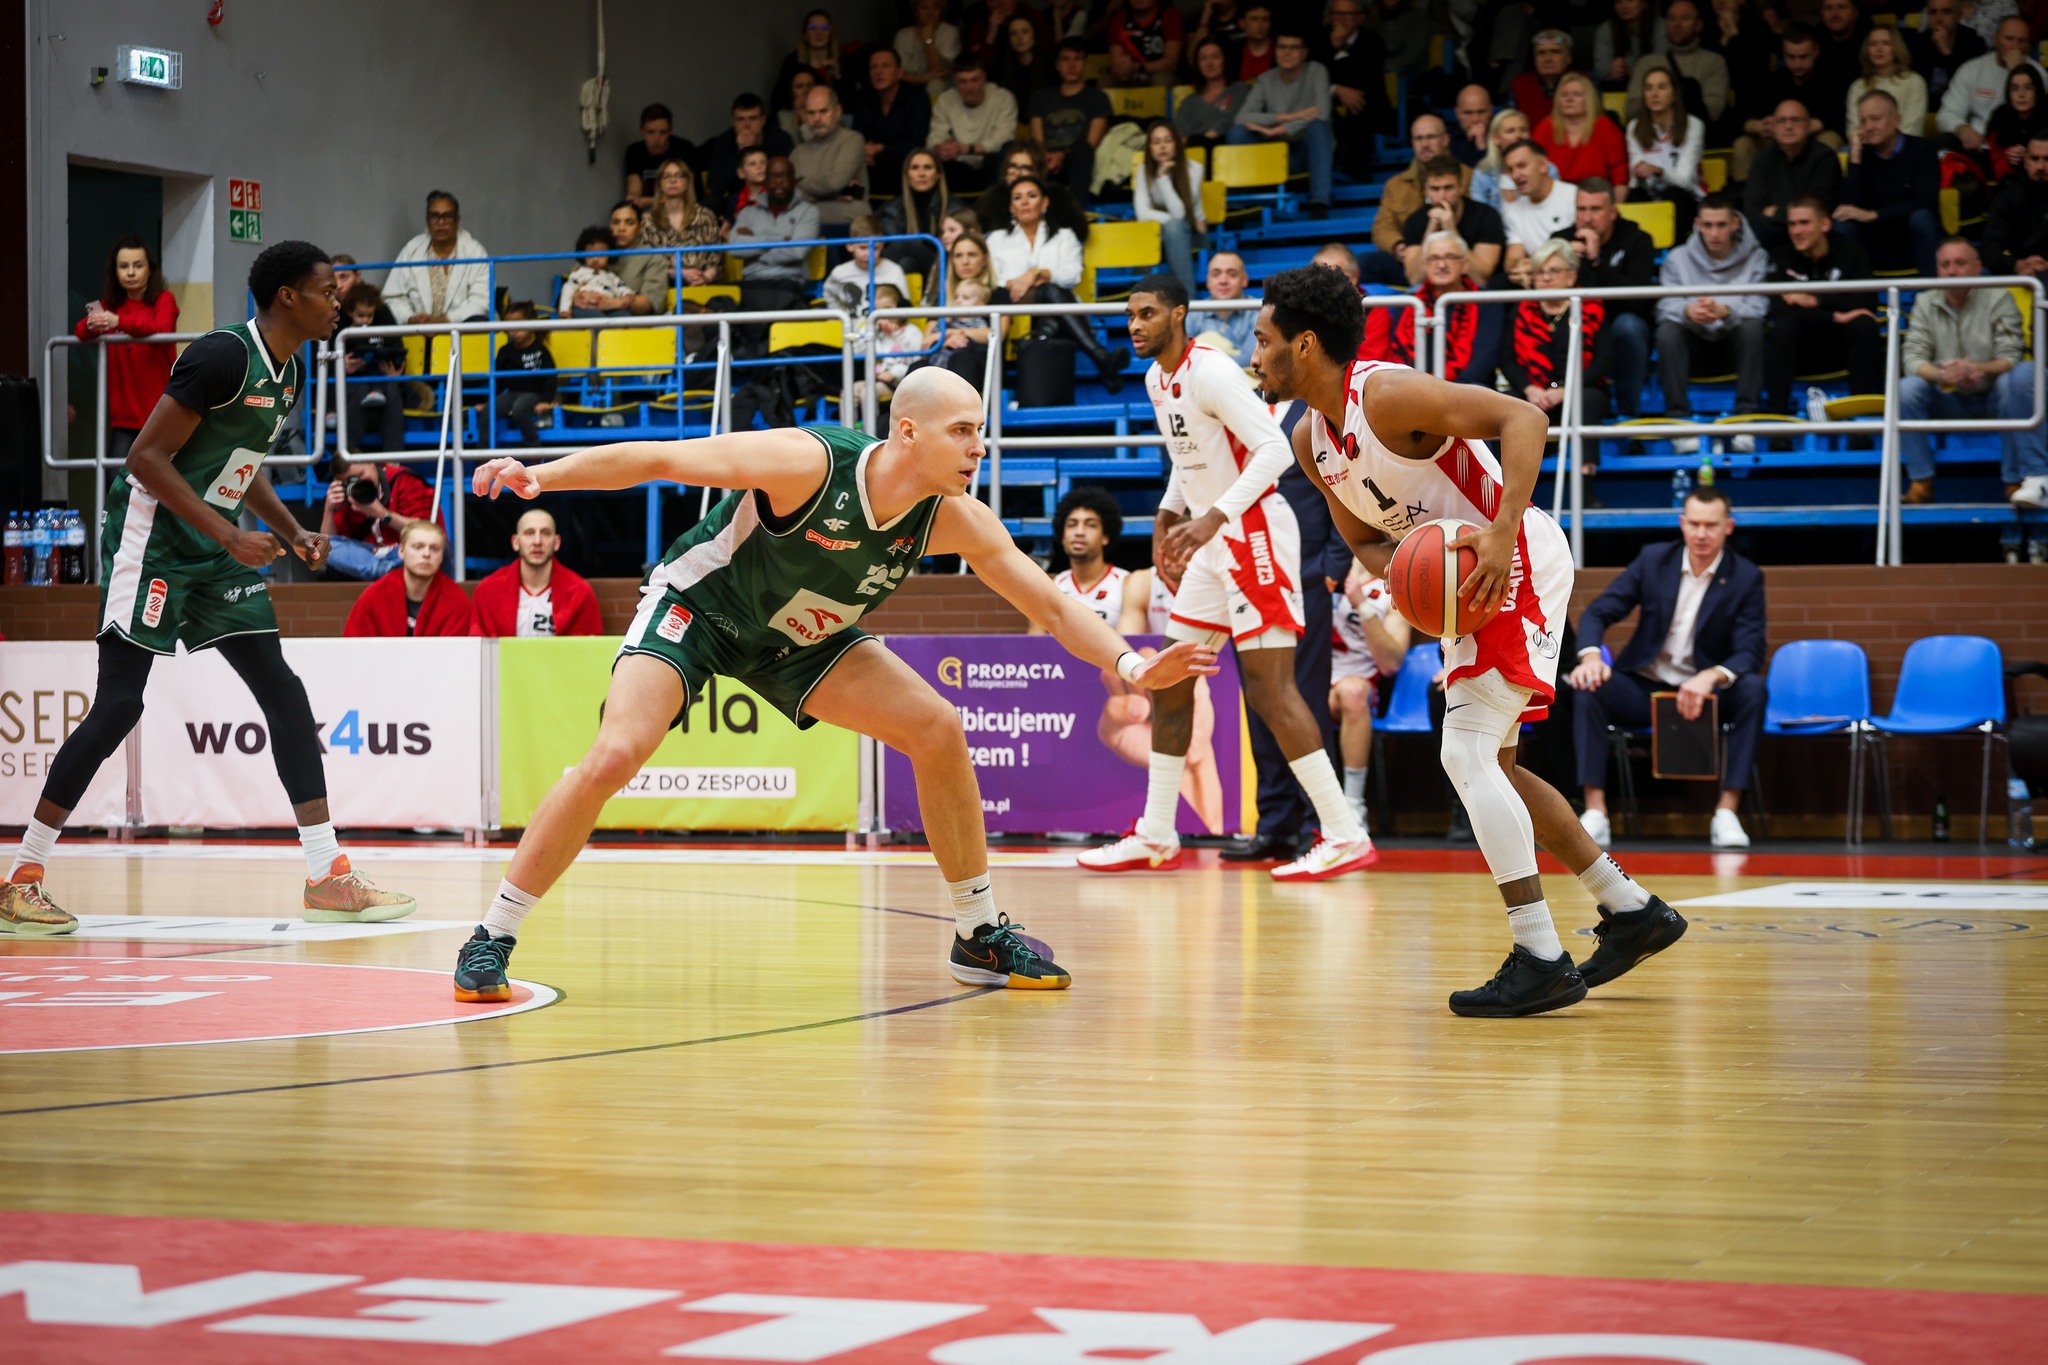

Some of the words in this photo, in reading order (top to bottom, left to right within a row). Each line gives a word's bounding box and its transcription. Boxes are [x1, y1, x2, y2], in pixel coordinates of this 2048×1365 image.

[1168, 413, 1189, 437] 12
[835, 491, 850, 511] C
[1362, 476, 1398, 512] 1
[807, 531, 833, 548] ORLEN
[1248, 529, 1275, 586] CZARNI
[967, 663, 1066, 680] PROPACTA
[967, 679, 1029, 690] Ubezpieczenia
[659, 774, 690, 791] DO
[697, 773, 787, 791] ZESPOŁU
